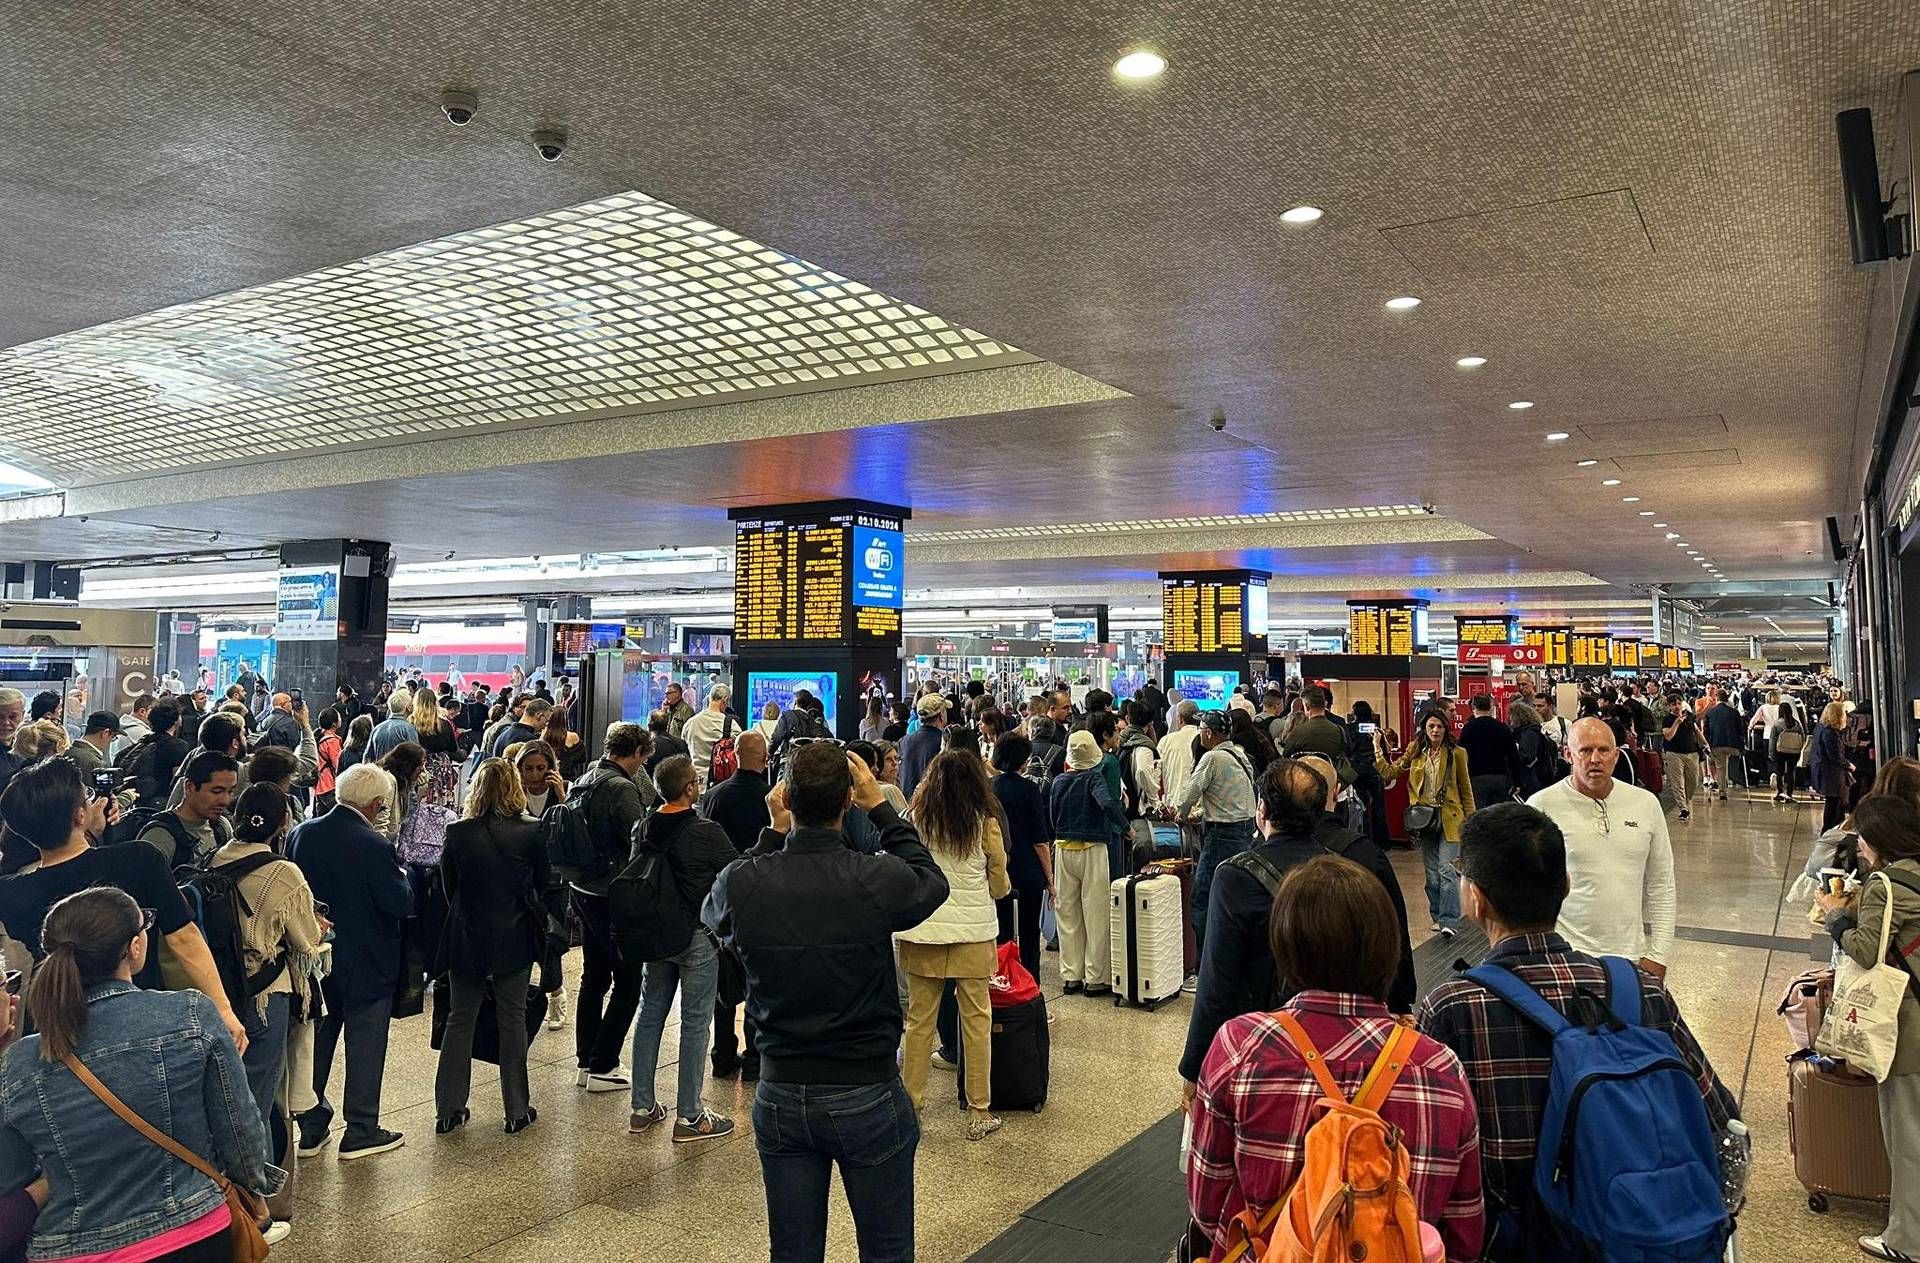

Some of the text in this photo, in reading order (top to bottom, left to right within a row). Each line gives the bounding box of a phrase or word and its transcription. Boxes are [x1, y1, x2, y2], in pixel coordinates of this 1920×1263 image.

[858, 516, 899, 531] 02.10.2024
[121, 656, 151, 666] GATE
[122, 671, 147, 698] C
[1845, 1008, 1858, 1024] A
